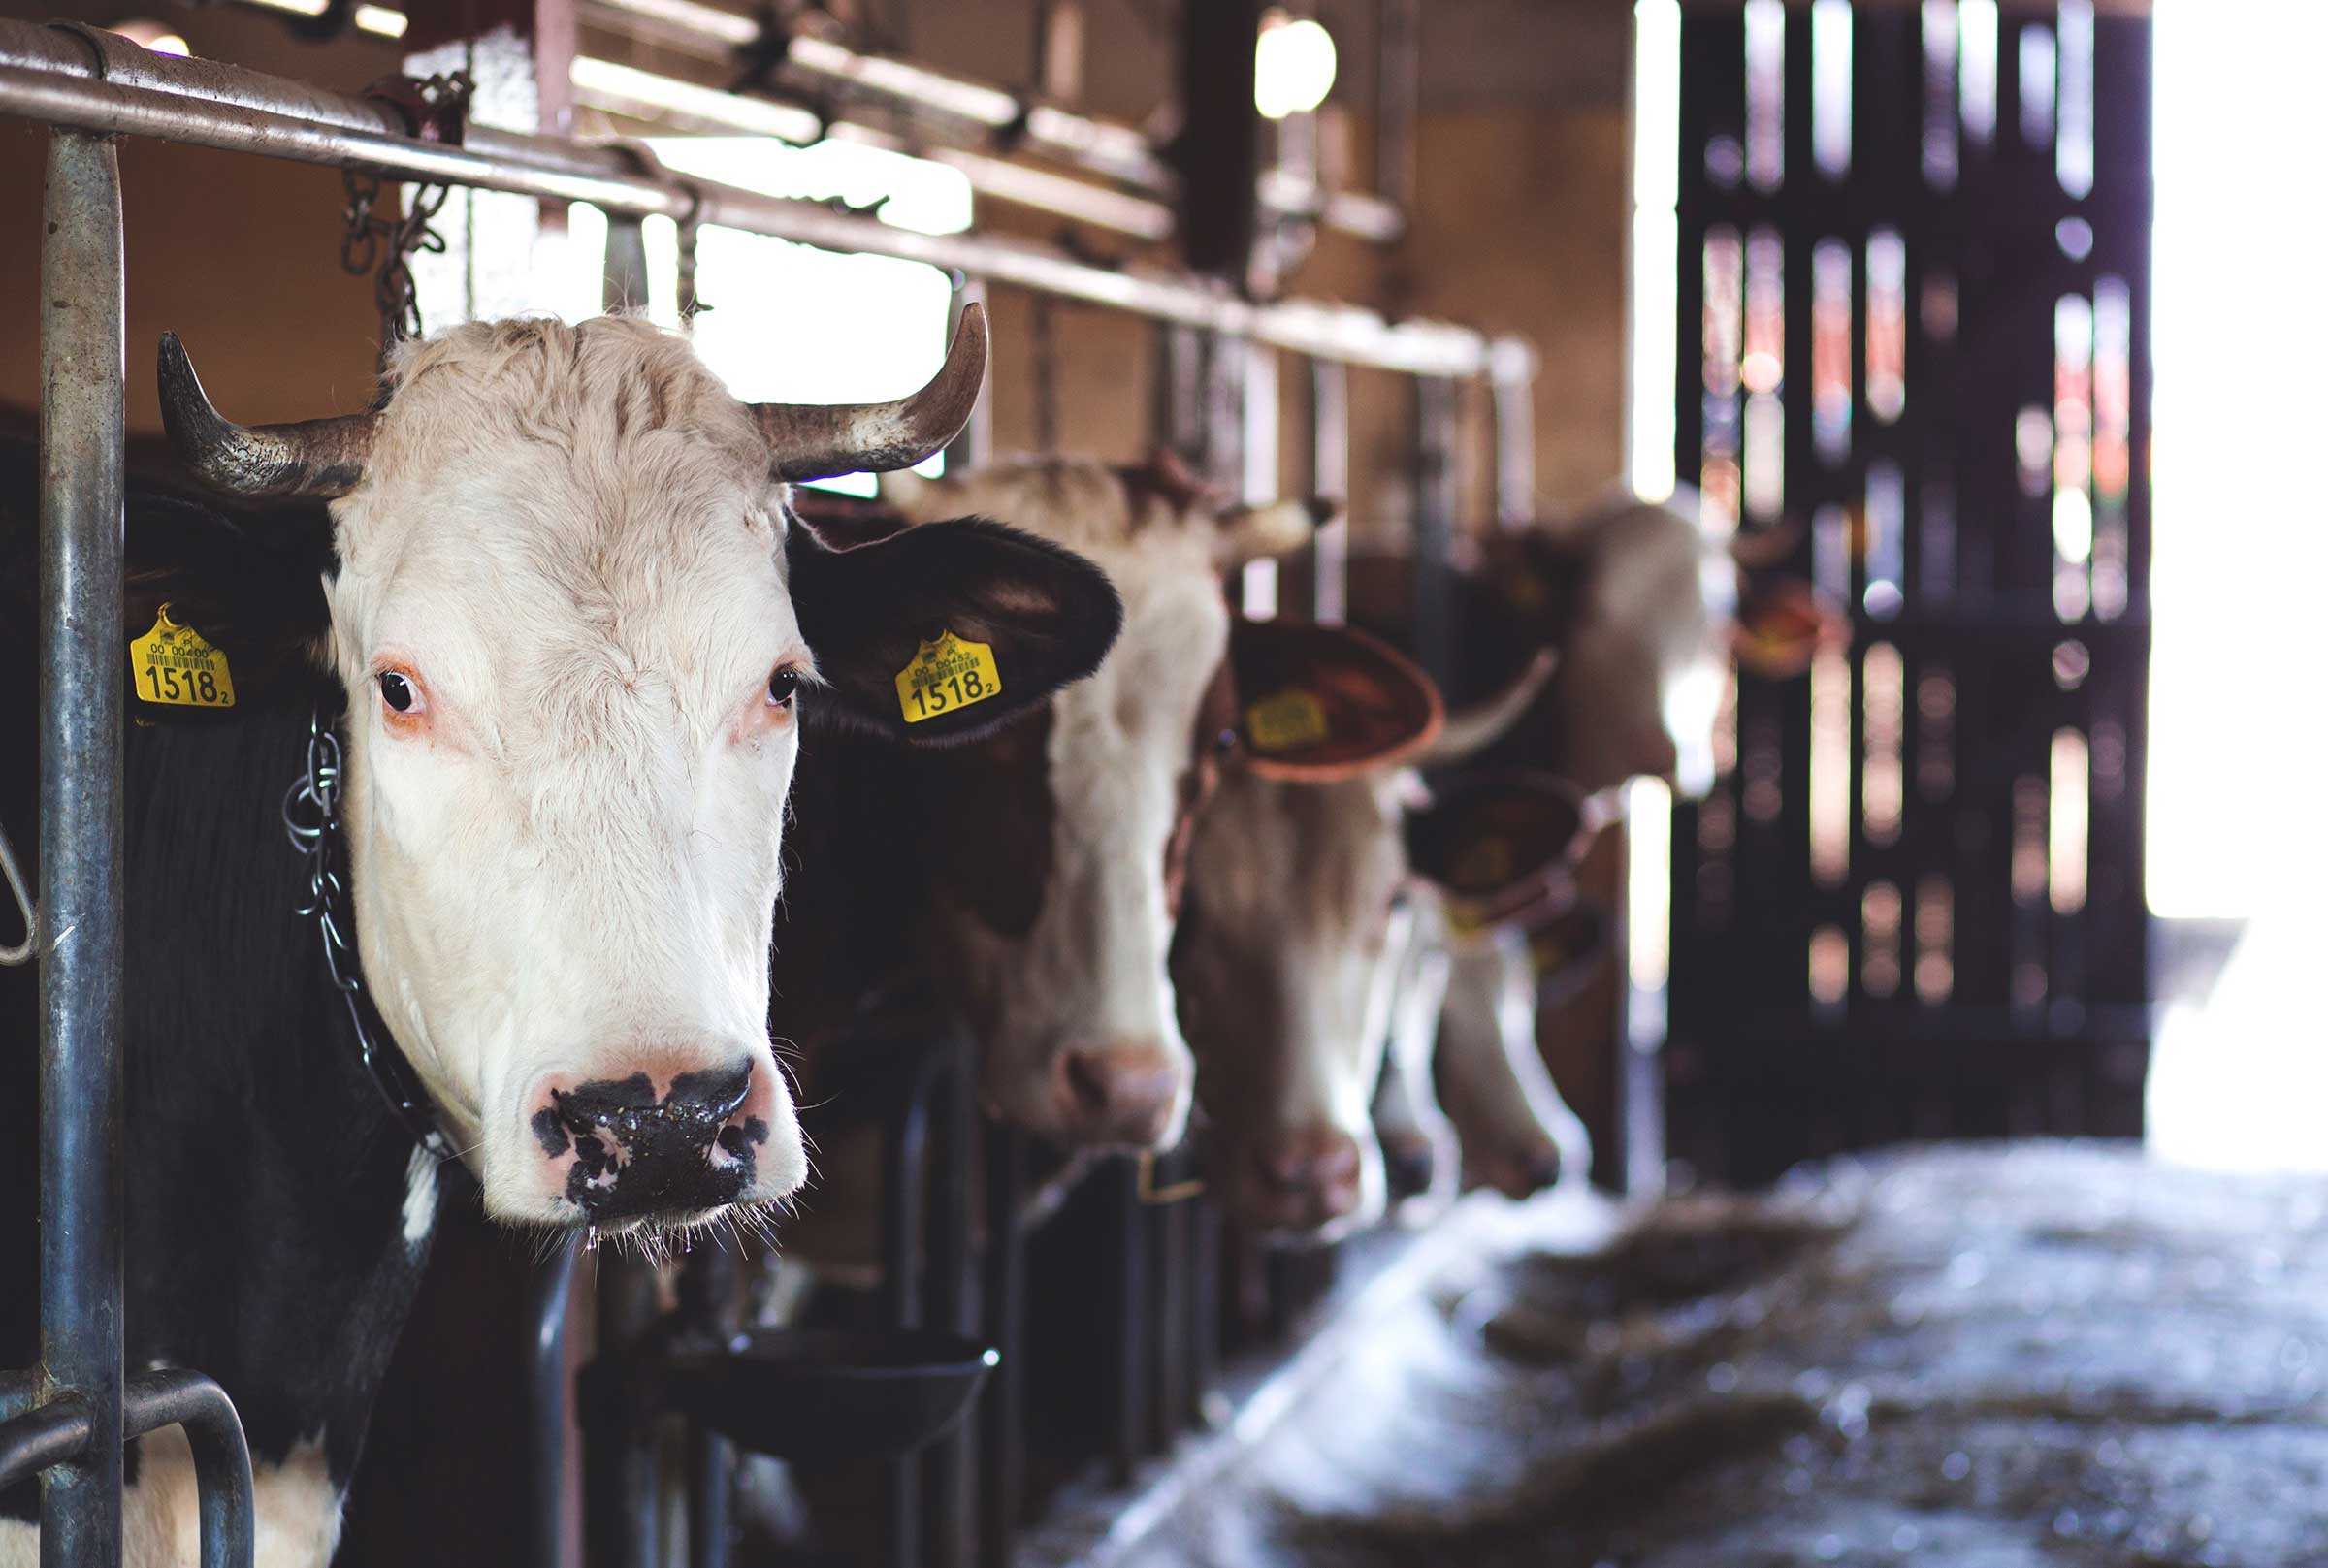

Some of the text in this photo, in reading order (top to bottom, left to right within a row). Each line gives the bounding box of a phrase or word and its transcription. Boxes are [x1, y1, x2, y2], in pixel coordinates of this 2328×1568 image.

[150, 643, 165, 655] 00
[146, 666, 229, 704] 1518 2
[912, 670, 993, 715] 1518 2
